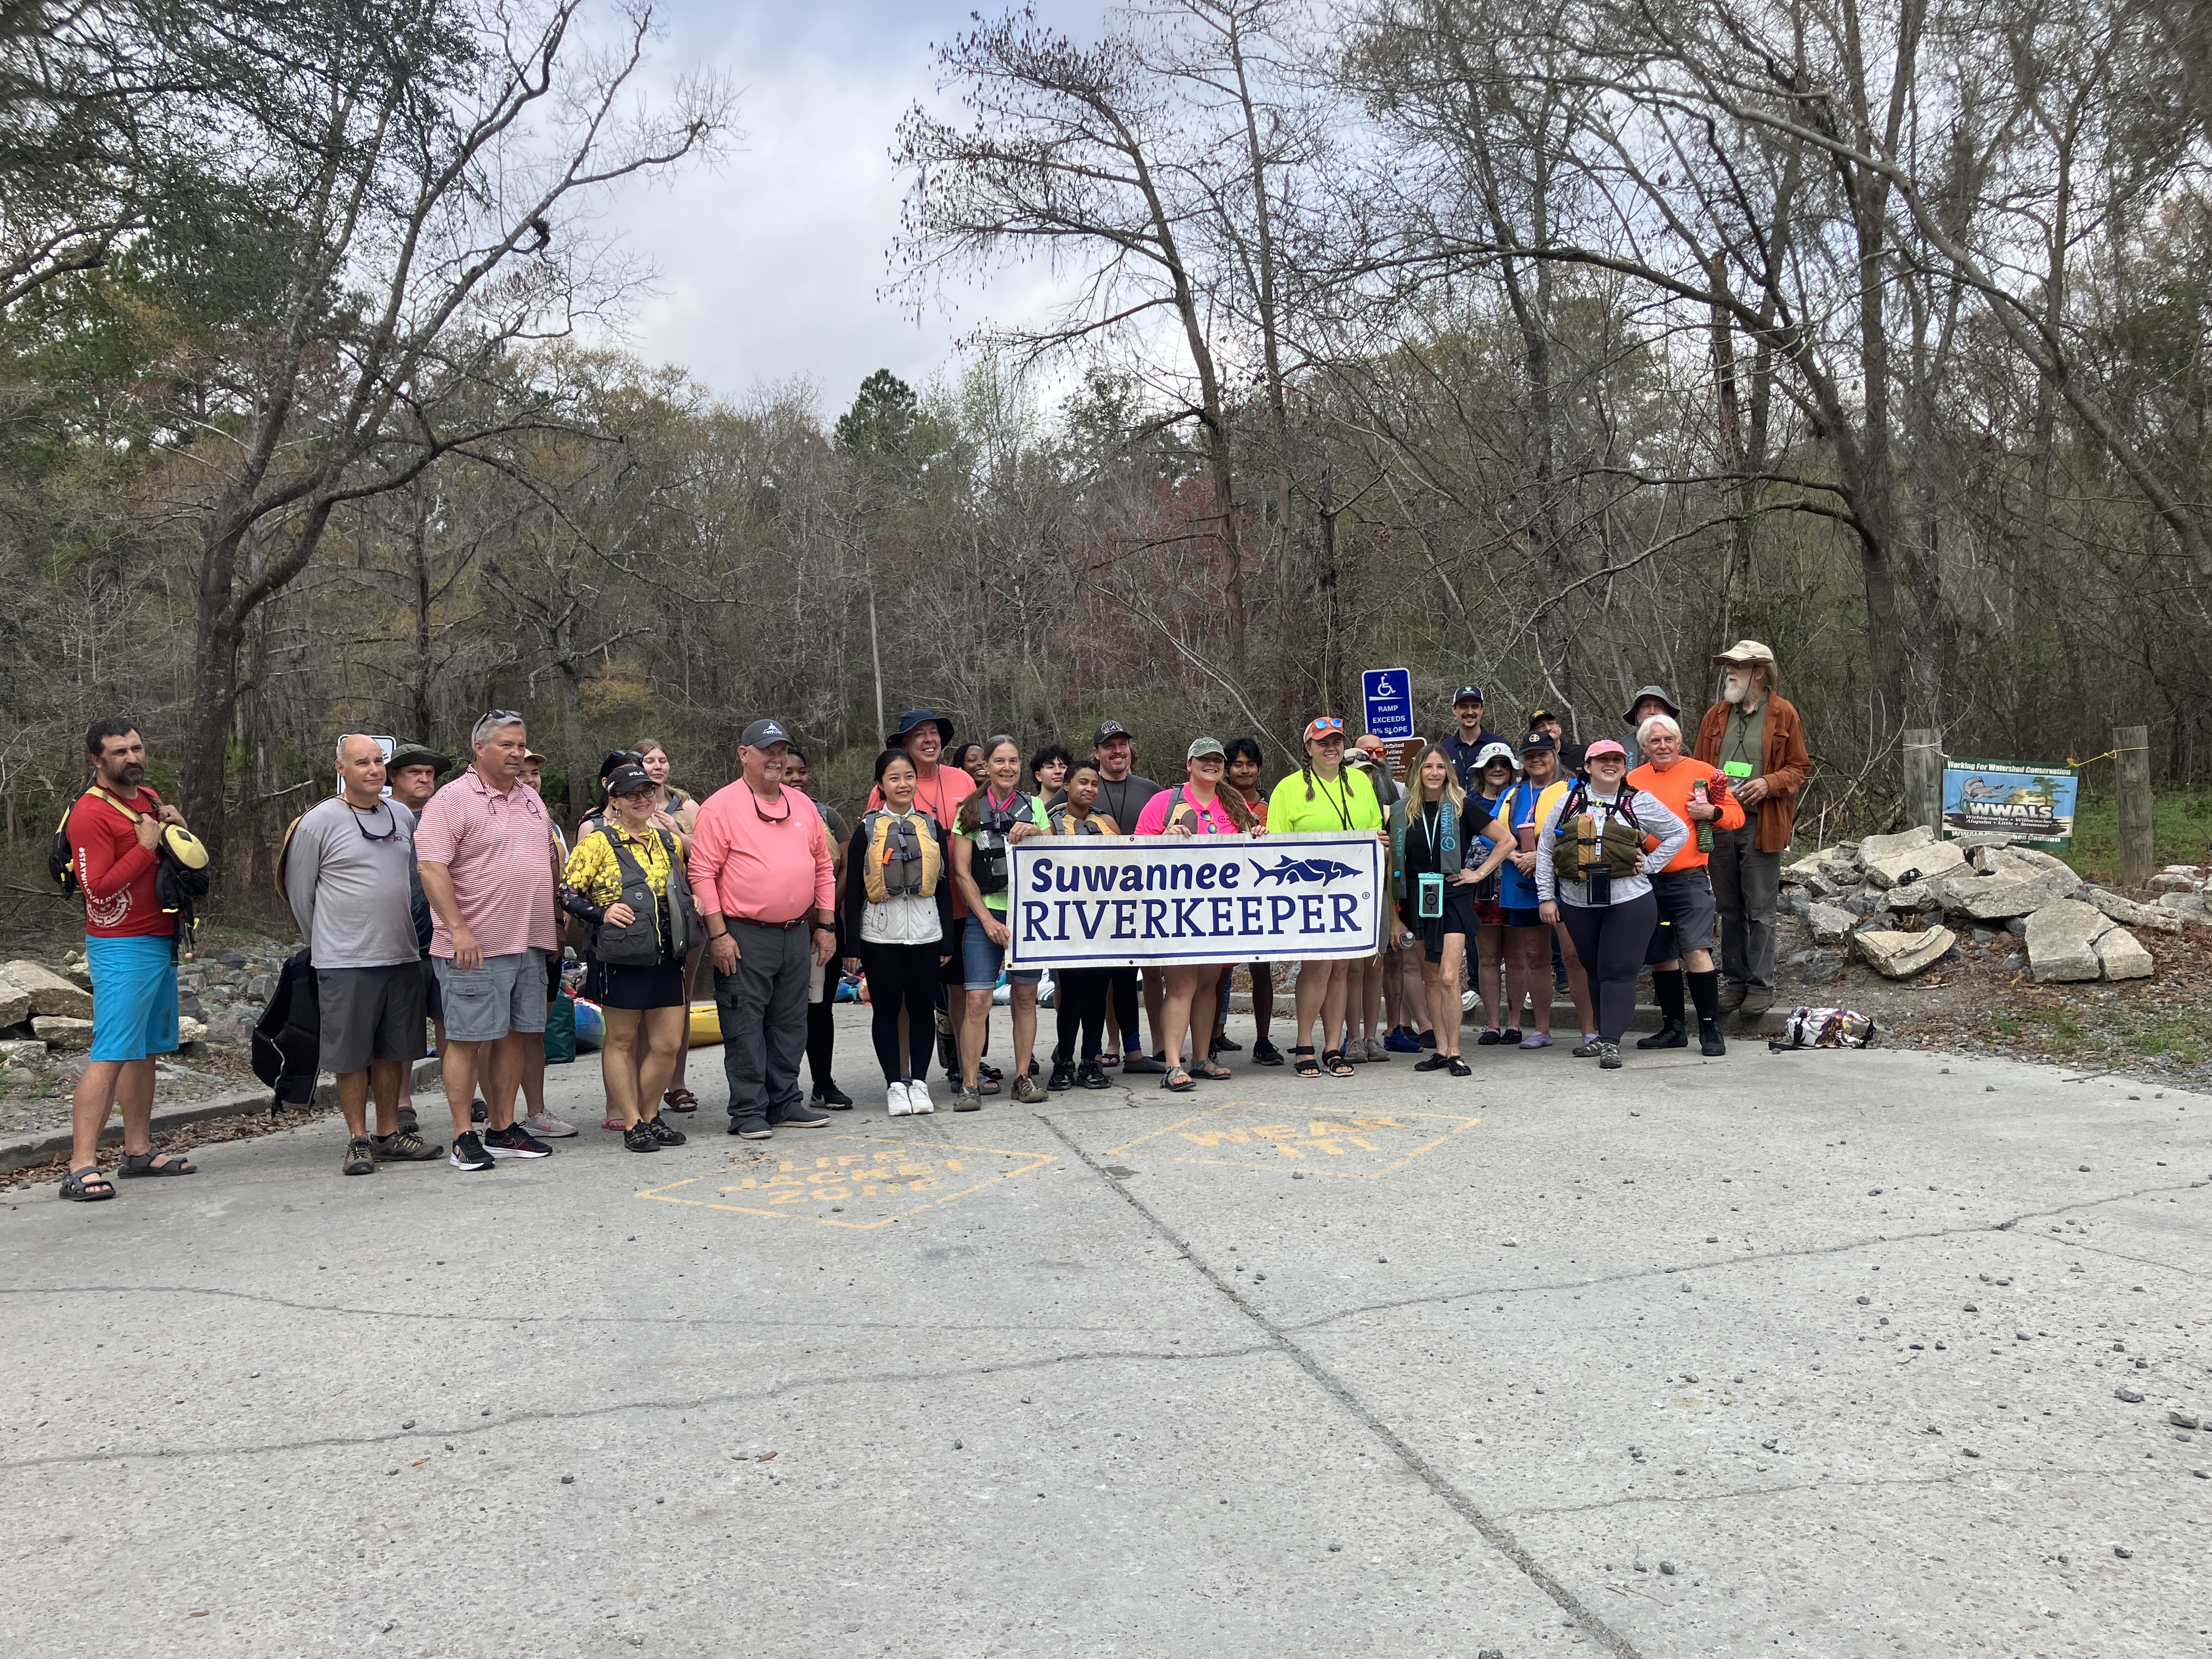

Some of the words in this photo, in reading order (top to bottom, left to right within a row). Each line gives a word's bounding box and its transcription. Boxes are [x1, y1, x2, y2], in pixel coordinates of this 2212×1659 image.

[1373, 715, 1406, 724] EXCEEDS
[1384, 725, 1408, 734] SLOPE
[1947, 761, 1976, 770] Working
[1976, 763, 1988, 771] For
[1988, 764, 2025, 773] Watershed
[2025, 766, 2071, 776] Conservation
[1970, 802, 2052, 819] WWALS
[2028, 834, 2062, 843] Coalition
[1031, 857, 1240, 893] Suwannee
[1178, 1117, 1411, 1147] WEAR
[778, 1149, 910, 1172] LIFE
[719, 1156, 970, 1190] JACKET
[768, 1176, 945, 1205] ZONE
